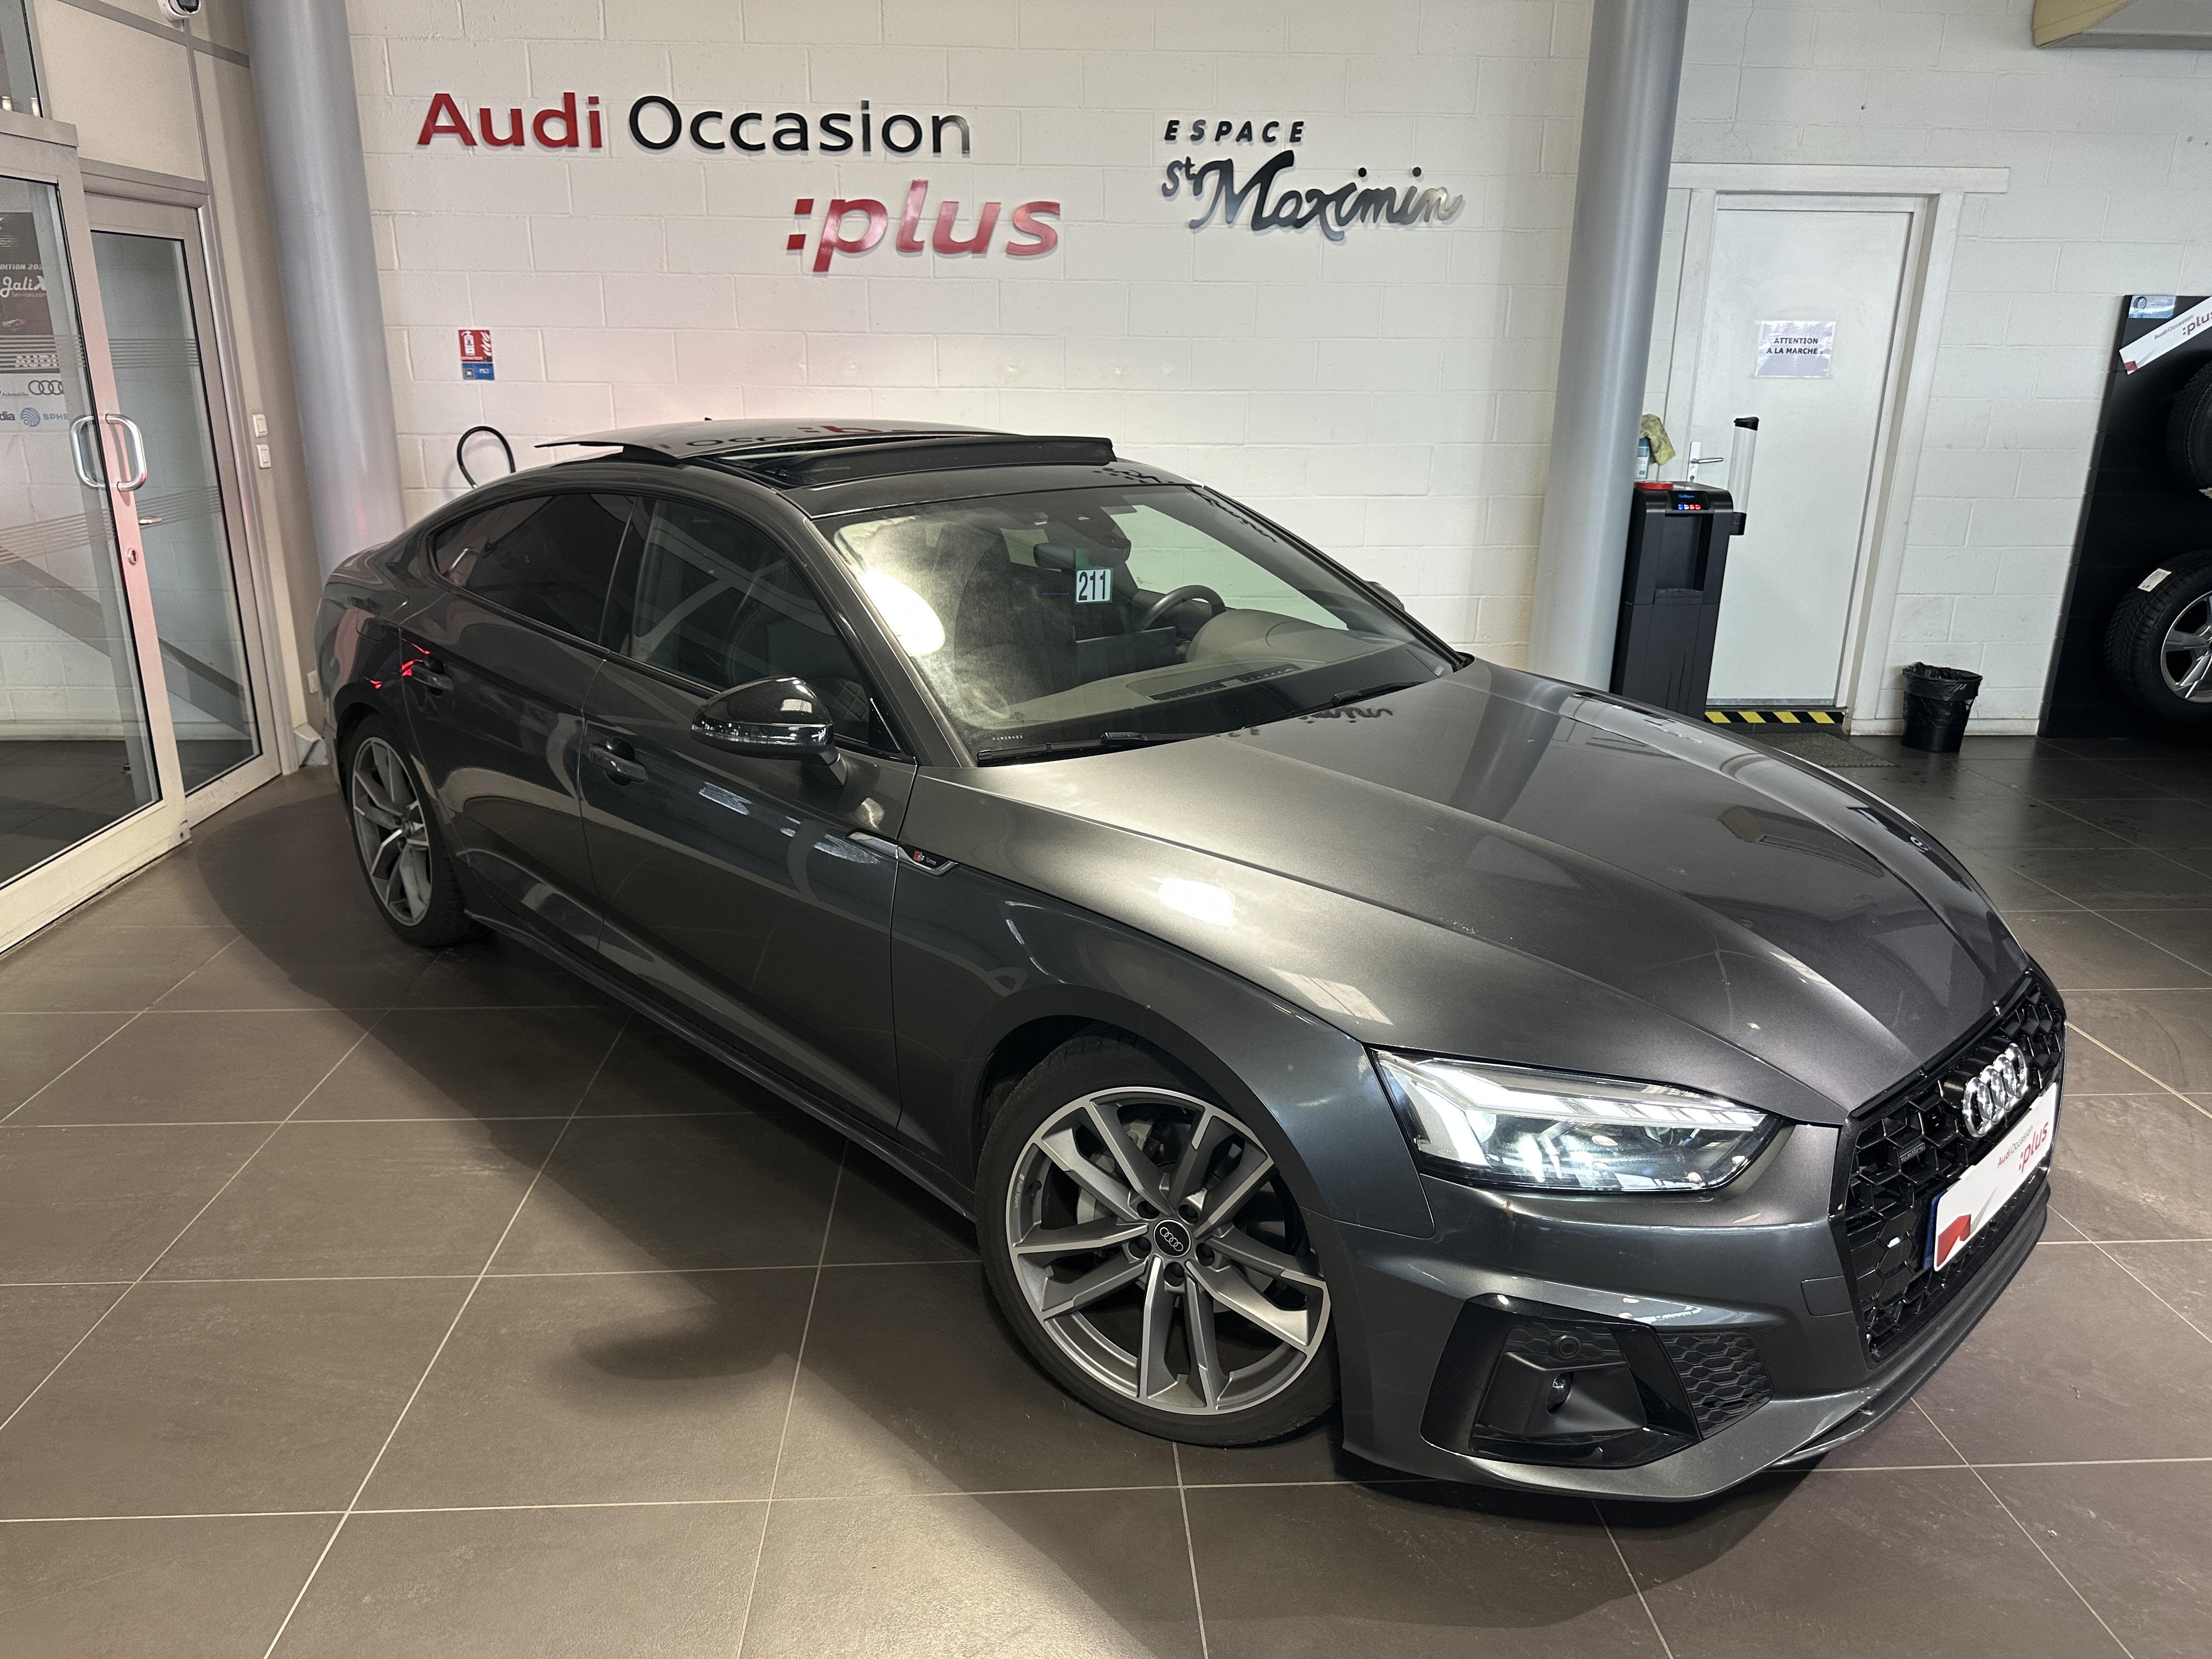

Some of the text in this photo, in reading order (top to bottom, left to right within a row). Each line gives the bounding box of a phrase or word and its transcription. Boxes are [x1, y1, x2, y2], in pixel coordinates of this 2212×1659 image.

[417, 92, 970, 154] Audi Occasion
[1164, 119, 1304, 143] ESPACE
[1188, 150, 1463, 241] Maximin
[787, 179, 1061, 273] :plus
[2154, 329, 2168, 340] Audi
[1078, 571, 1105, 601] 211
[1997, 1146, 2011, 1168] Audi
[2018, 1121, 2048, 1173] :plus
